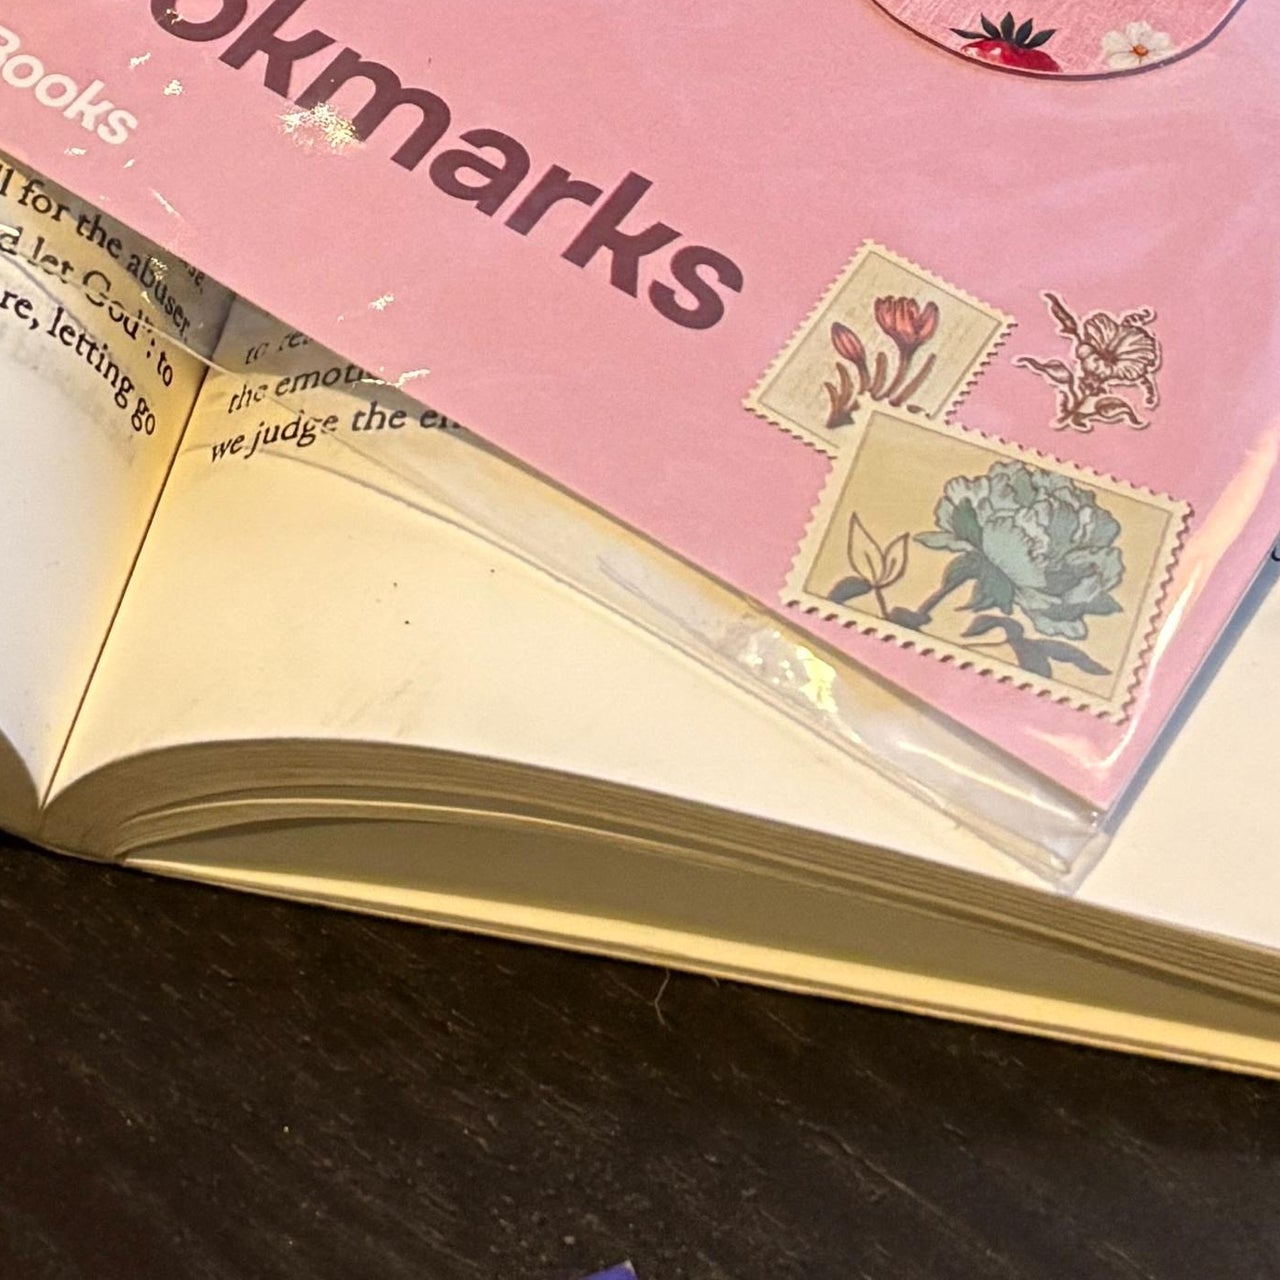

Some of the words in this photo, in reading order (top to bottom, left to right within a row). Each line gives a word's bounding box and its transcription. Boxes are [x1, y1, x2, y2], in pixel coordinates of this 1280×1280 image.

[17, 178, 71, 222] for
[76, 213, 123, 259] the
[46, 304, 136, 411] letting
[130, 401, 157, 438] go
[156, 350, 174, 387] to
[211, 433, 247, 464] we
[244, 408, 340, 459] judge
[350, 400, 407, 433] the
